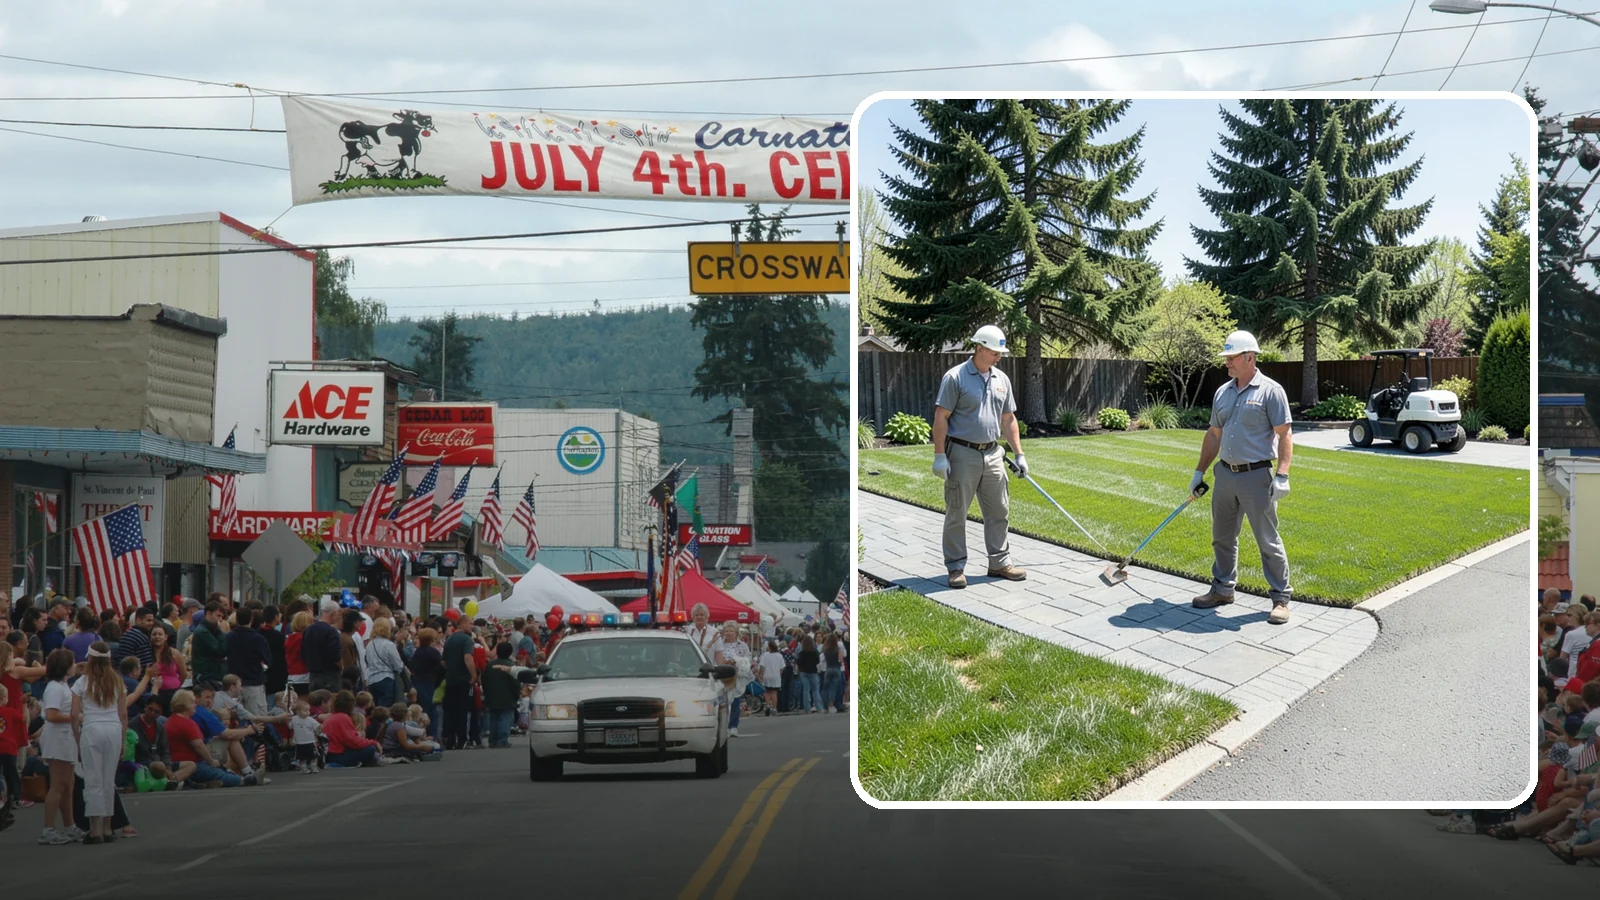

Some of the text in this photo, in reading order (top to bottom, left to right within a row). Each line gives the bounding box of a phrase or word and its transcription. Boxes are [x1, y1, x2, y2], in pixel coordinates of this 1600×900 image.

[695, 121, 850, 150] Carnat
[481, 141, 605, 192] JULY
[632, 150, 746, 197] 4th.
[697, 253, 850, 280] CROSSWA
[283, 380, 373, 420] ACE
[406, 409, 452, 422] CEDAR
[283, 421, 371, 437] Hardware
[416, 428, 477, 447] Coca-Cola
[83, 485, 155, 495] St. Vincent de Paul
[213, 516, 331, 535] HARDARE
[688, 526, 742, 535] CRNATION
[699, 535, 730, 543] GLASS
